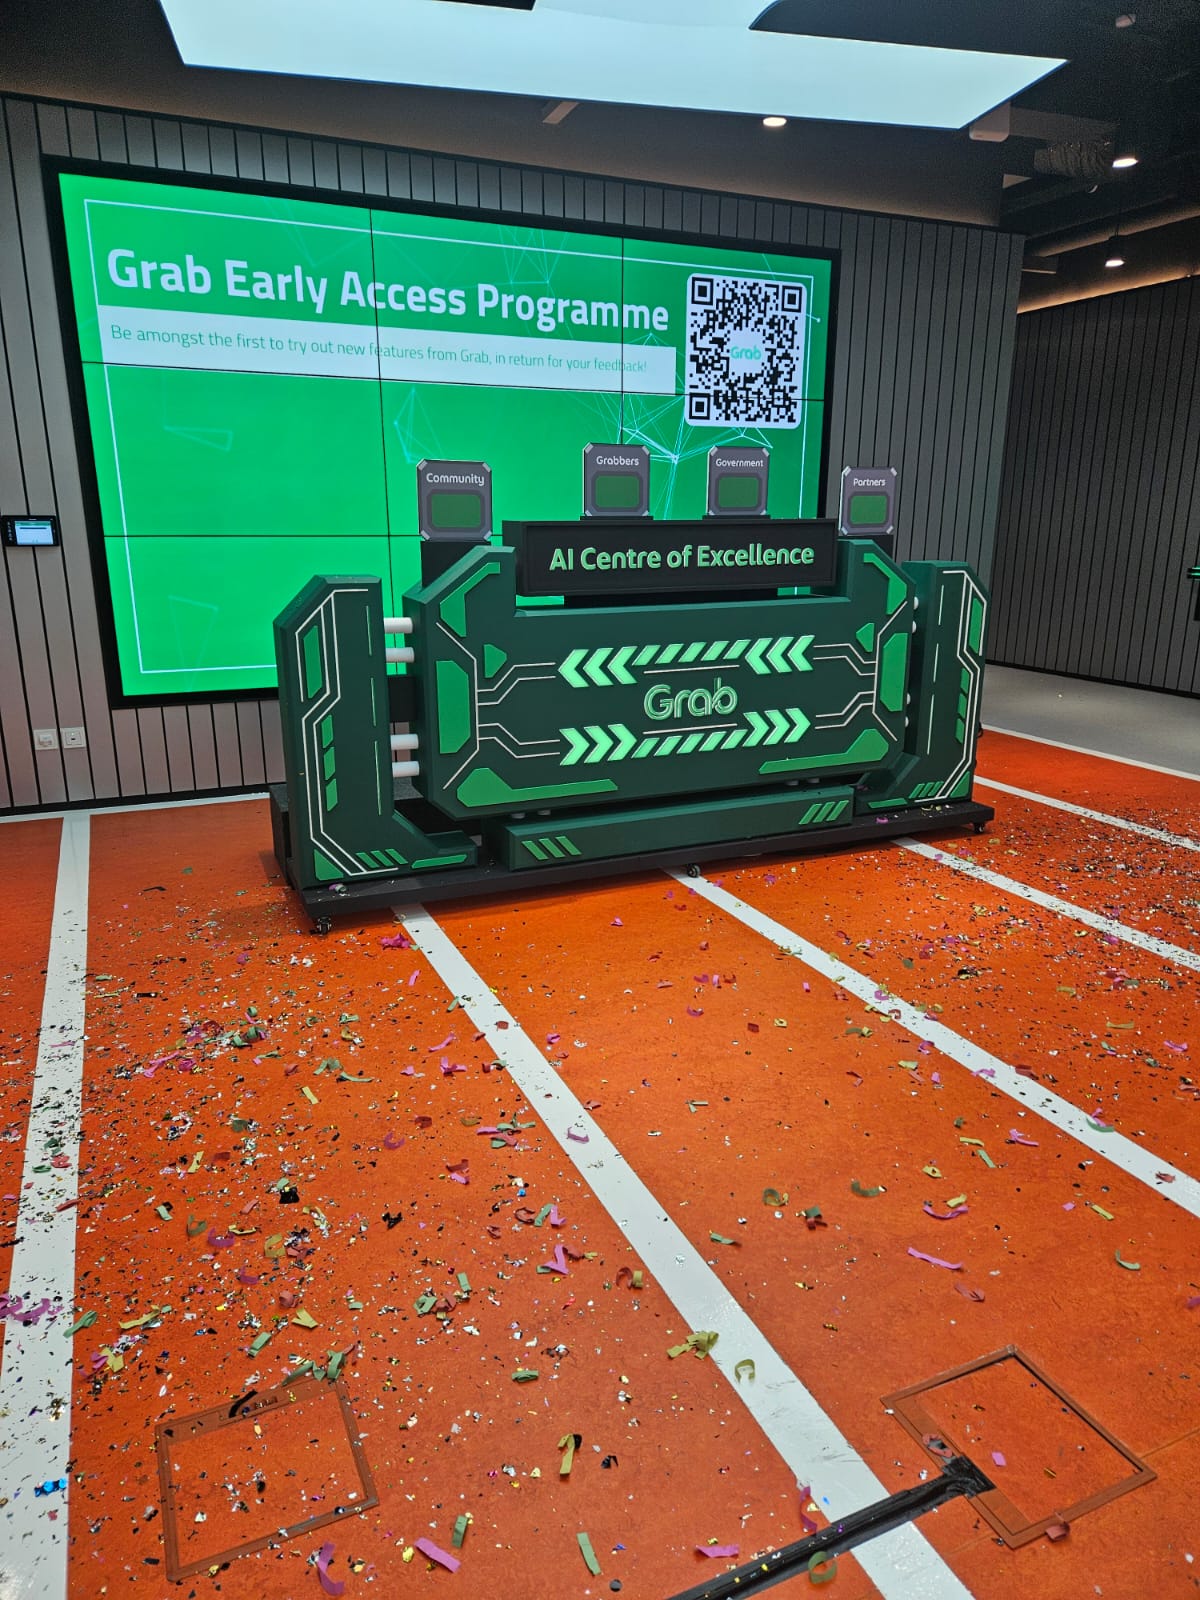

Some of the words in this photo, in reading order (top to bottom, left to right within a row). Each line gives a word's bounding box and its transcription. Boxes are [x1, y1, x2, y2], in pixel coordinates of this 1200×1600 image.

[107, 248, 212, 294] Grab
[224, 259, 328, 314] Early
[340, 271, 466, 315] Access
[478, 283, 669, 332] Programme
[111, 325, 132, 340] Be
[136, 328, 204, 348] amongst
[208, 331, 233, 347] the
[236, 333, 265, 350] first
[269, 337, 284, 351] to
[288, 339, 307, 355] try
[311, 340, 334, 354] out
[337, 344, 365, 355] new
[369, 343, 424, 359] features
[427, 346, 457, 361] from
[460, 348, 492, 365] Grab,
[495, 352, 506, 364] in
[508, 353, 545, 367] return
[547, 354, 563, 367] for
[566, 359, 590, 371] your
[594, 358, 647, 373] feedback!
[730, 345, 762, 360] Grab
[596, 456, 640, 466] Grabbers
[715, 458, 764, 468] Government
[426, 473, 485, 486] Community
[853, 478, 886, 487] Partners
[549, 549, 575, 571] AI
[580, 548, 661, 570] Centre
[667, 545, 692, 567] of
[697, 544, 815, 567] Excellence
[643, 677, 738, 721] Grab
